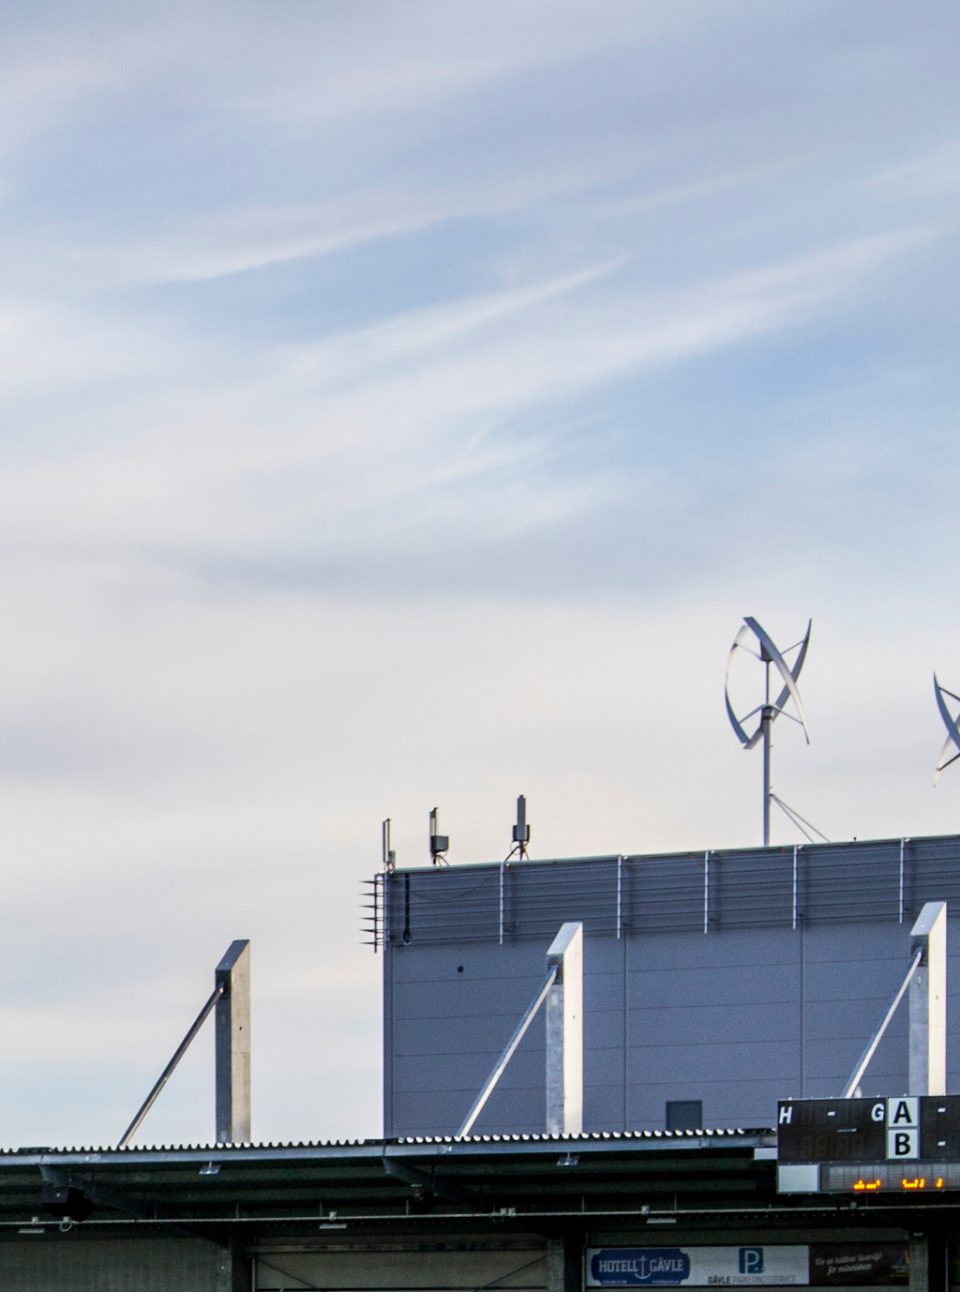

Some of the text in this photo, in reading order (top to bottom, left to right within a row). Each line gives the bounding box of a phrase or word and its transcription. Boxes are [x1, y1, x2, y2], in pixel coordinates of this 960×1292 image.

[779, 1105, 793, 1125] H
[871, 1103, 885, 1122] G
[893, 1101, 912, 1124] A
[895, 1133, 910, 1156] B
[599, 1257, 684, 1273] HOTELL GÄVLE
